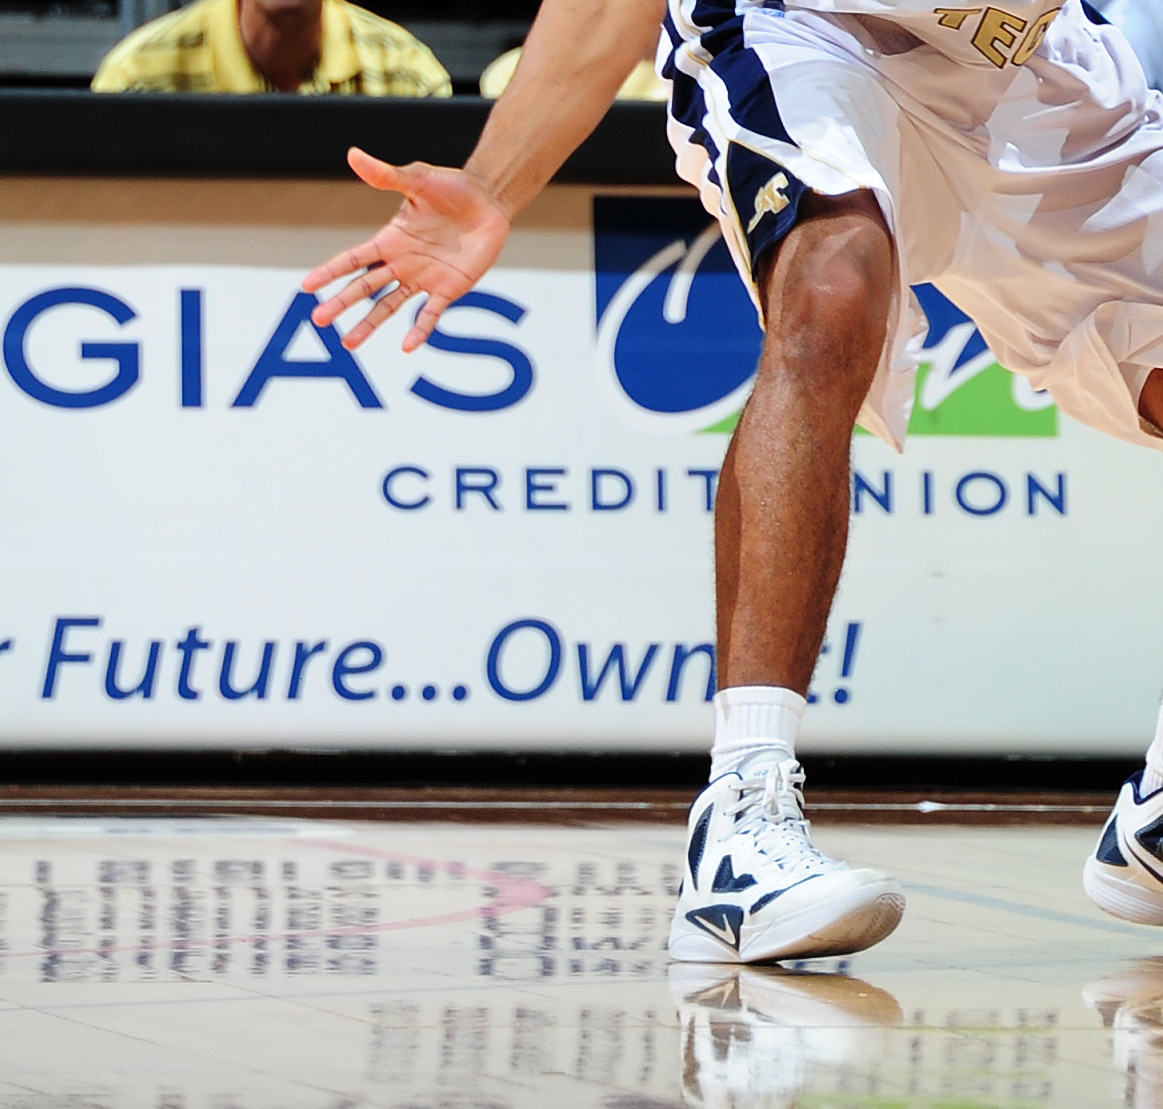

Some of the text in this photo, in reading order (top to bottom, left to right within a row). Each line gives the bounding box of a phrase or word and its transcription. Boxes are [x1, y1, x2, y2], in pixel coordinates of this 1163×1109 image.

[2, 286, 534, 412] GIAS
[383, 466, 1067, 515] CREDIT NION
